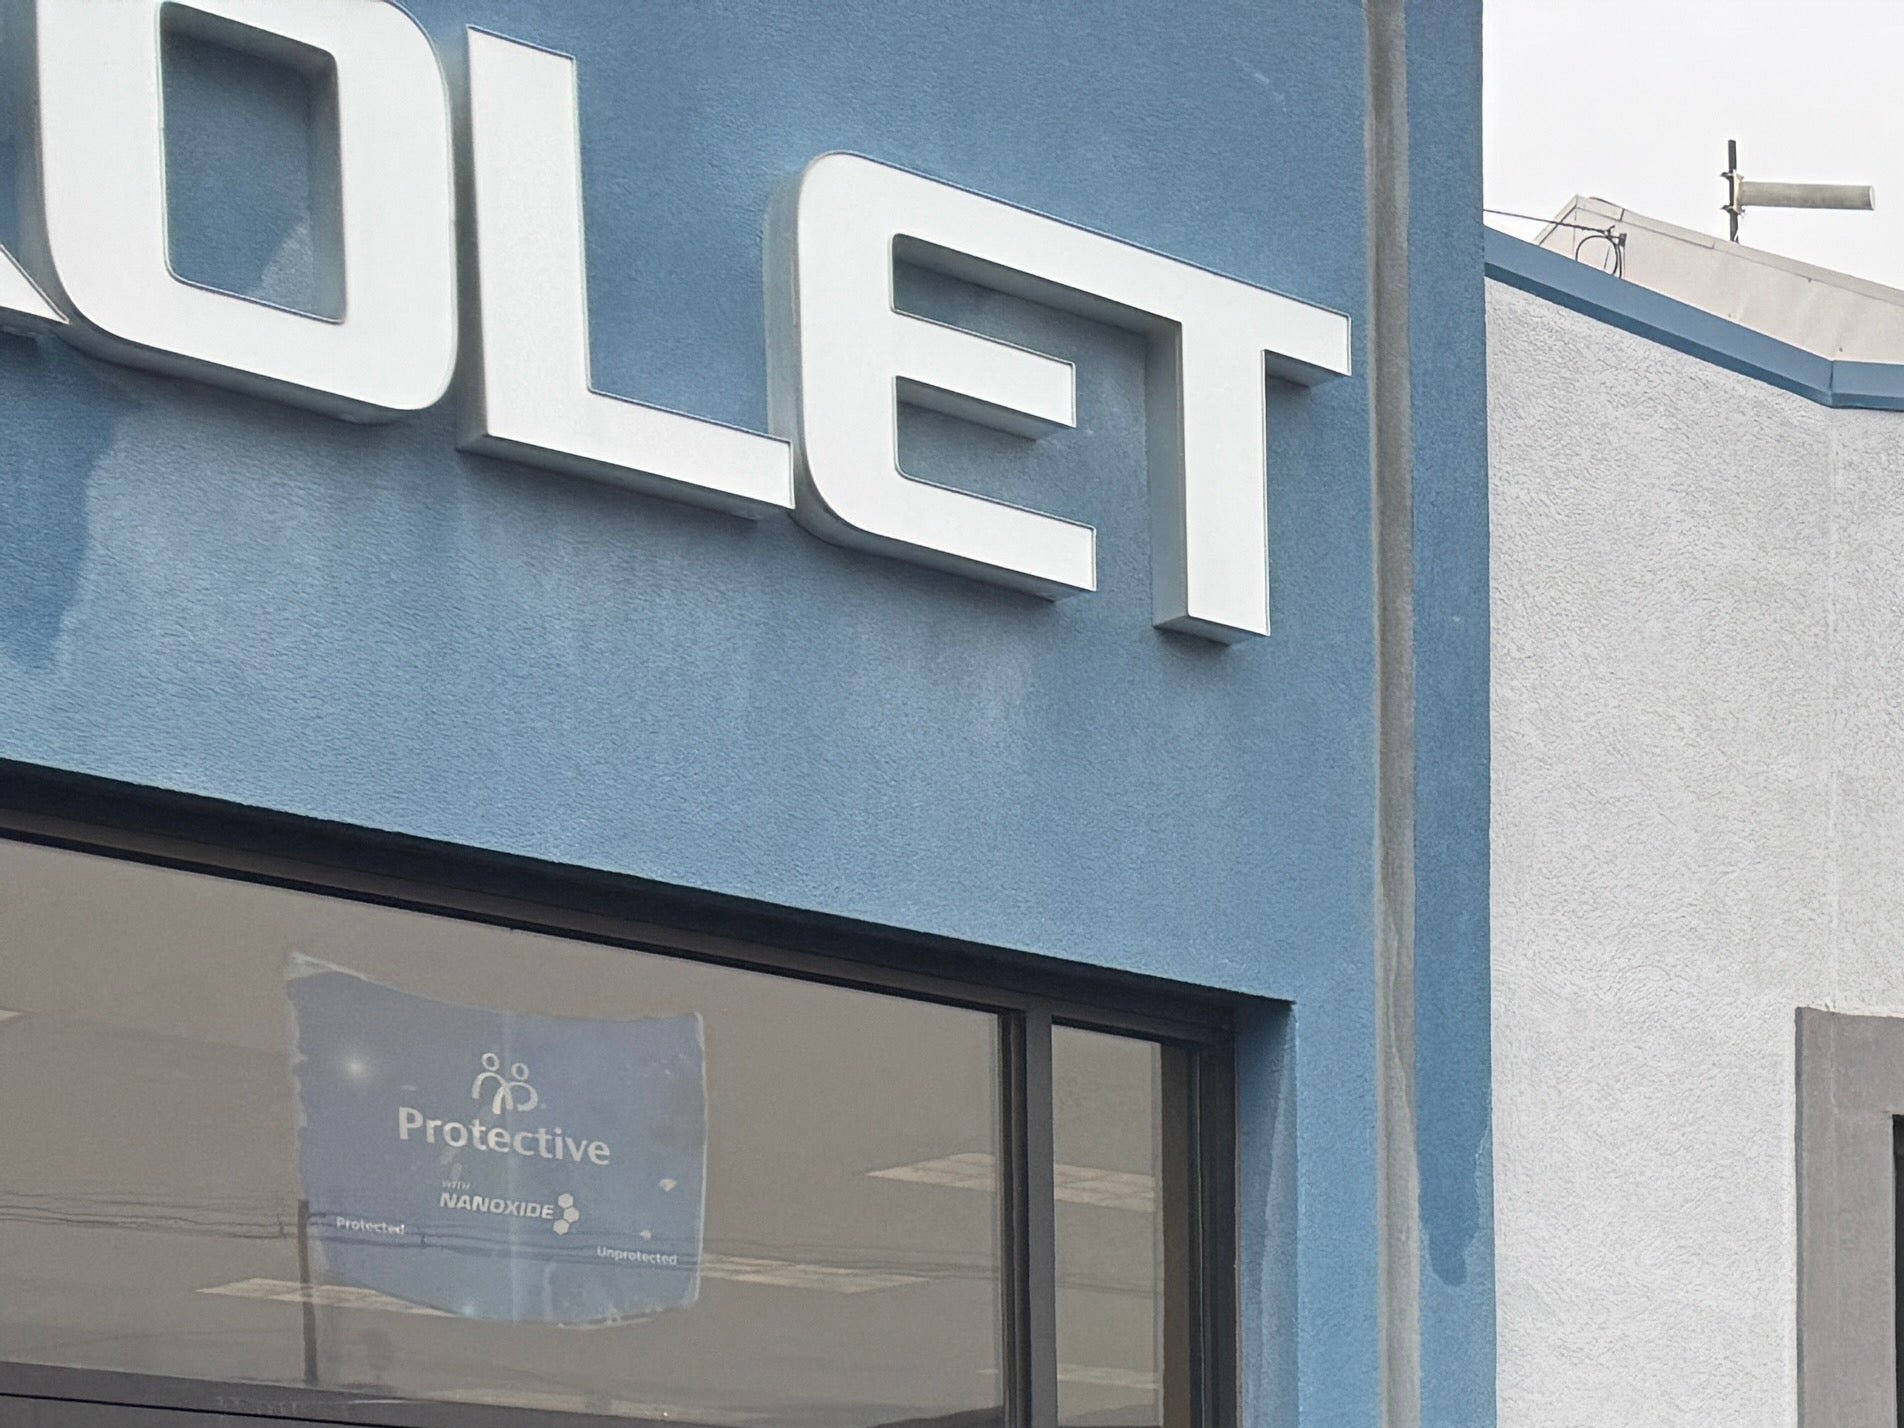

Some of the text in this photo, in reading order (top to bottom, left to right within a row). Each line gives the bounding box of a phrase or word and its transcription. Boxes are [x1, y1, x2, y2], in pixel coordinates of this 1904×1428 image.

[0, 0, 1351, 638] OLET
[400, 1106, 611, 1166] Protective
[440, 1193, 554, 1221] NANOXIDE
[336, 1216, 405, 1236] Protected
[597, 1245, 678, 1266] Unprotected
